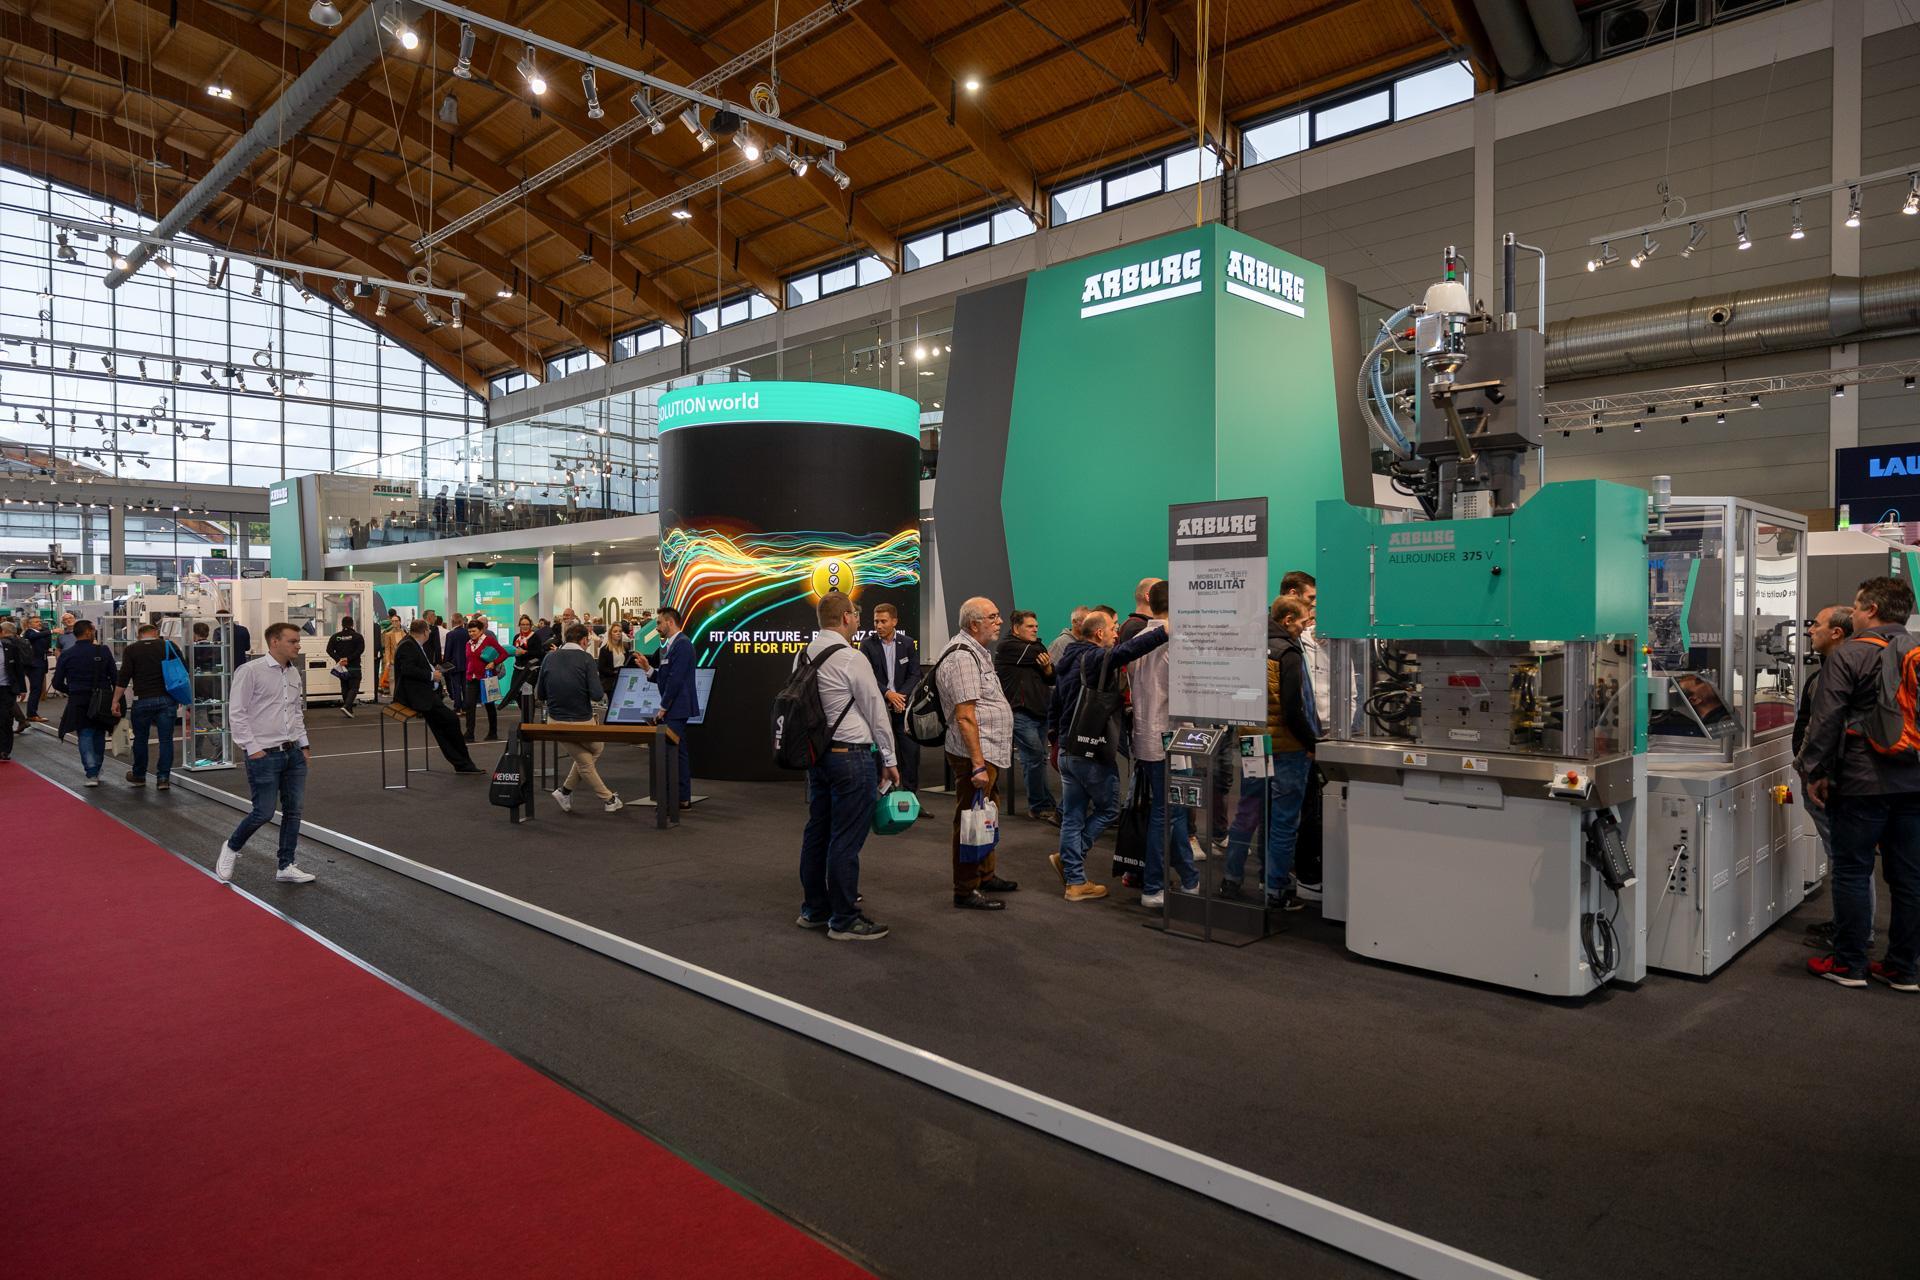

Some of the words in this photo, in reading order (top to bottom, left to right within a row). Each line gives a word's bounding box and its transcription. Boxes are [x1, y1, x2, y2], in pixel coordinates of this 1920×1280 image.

[1082, 249, 1201, 303] ARBURG
[1227, 250, 1304, 303] ARBURG
[707, 392, 759, 411] world
[1177, 515, 1257, 536] ARBURG
[1389, 530, 1455, 545] ARBURG
[1390, 552, 1456, 564] ALLROUNDER
[1462, 551, 1482, 561] 375
[1486, 551, 1494, 561] V
[1188, 578, 1246, 590] MOBILITÄT
[622, 597, 642, 606] JAHRE
[709, 631, 725, 642] FIT
[727, 631, 750, 642] FOR
[753, 631, 801, 642] FUTURE
[734, 643, 751, 653] FIT
[754, 643, 778, 653] FOR
[776, 715, 784, 749] FILA
[1077, 735, 1090, 743] WIR
[496, 773, 520, 781] KEYENCE
[1124, 857, 1138, 866] SIND
